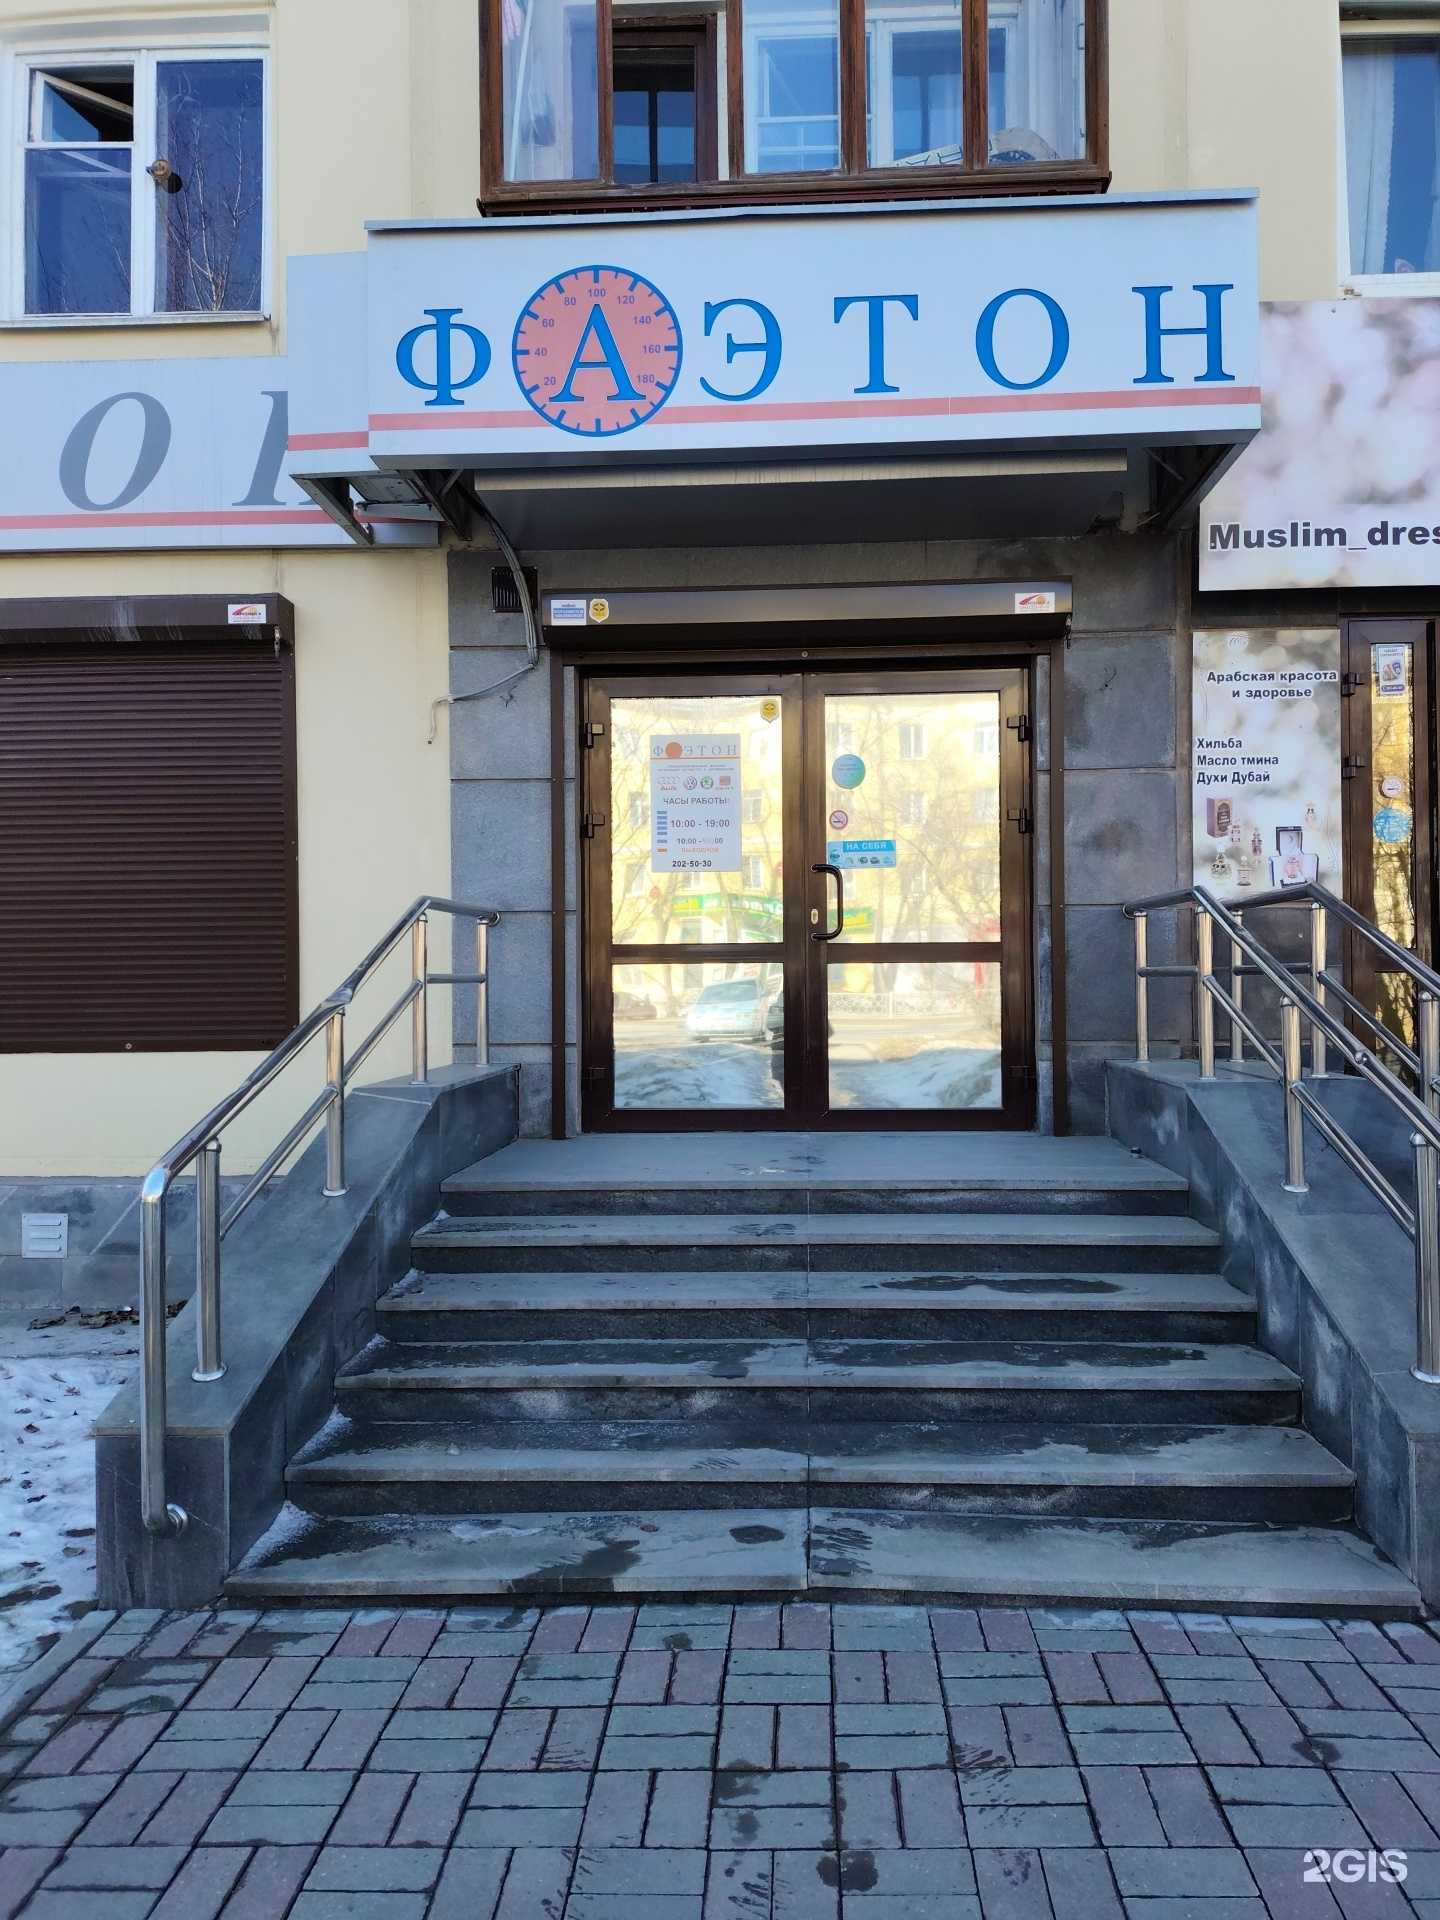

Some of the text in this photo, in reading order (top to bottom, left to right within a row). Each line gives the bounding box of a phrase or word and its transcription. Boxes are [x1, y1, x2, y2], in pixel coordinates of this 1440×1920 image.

[587, 287, 607, 298] 100
[563, 296, 577, 306] 80
[616, 294, 635, 305] 120
[542, 317, 555, 328] 60
[633, 314, 652, 325] 140
[395, 283, 1236, 406] ФАЭТОН
[642, 343, 661, 354] 160
[534, 347, 548, 357] 40
[543, 376, 557, 387] 20
[637, 374, 655, 385] 180
[1207, 670, 1337, 684] Арабская красота
[1232, 687, 1312, 700] и здоровье
[1196, 738, 1242, 749] Хильба
[1197, 755, 1279, 766] Масло тмина
[1196, 770, 1270, 784] Духи Дубай
[671, 820, 696, 828] 10:00
[705, 819, 730, 828] 19:00
[846, 842, 859, 850] НА
